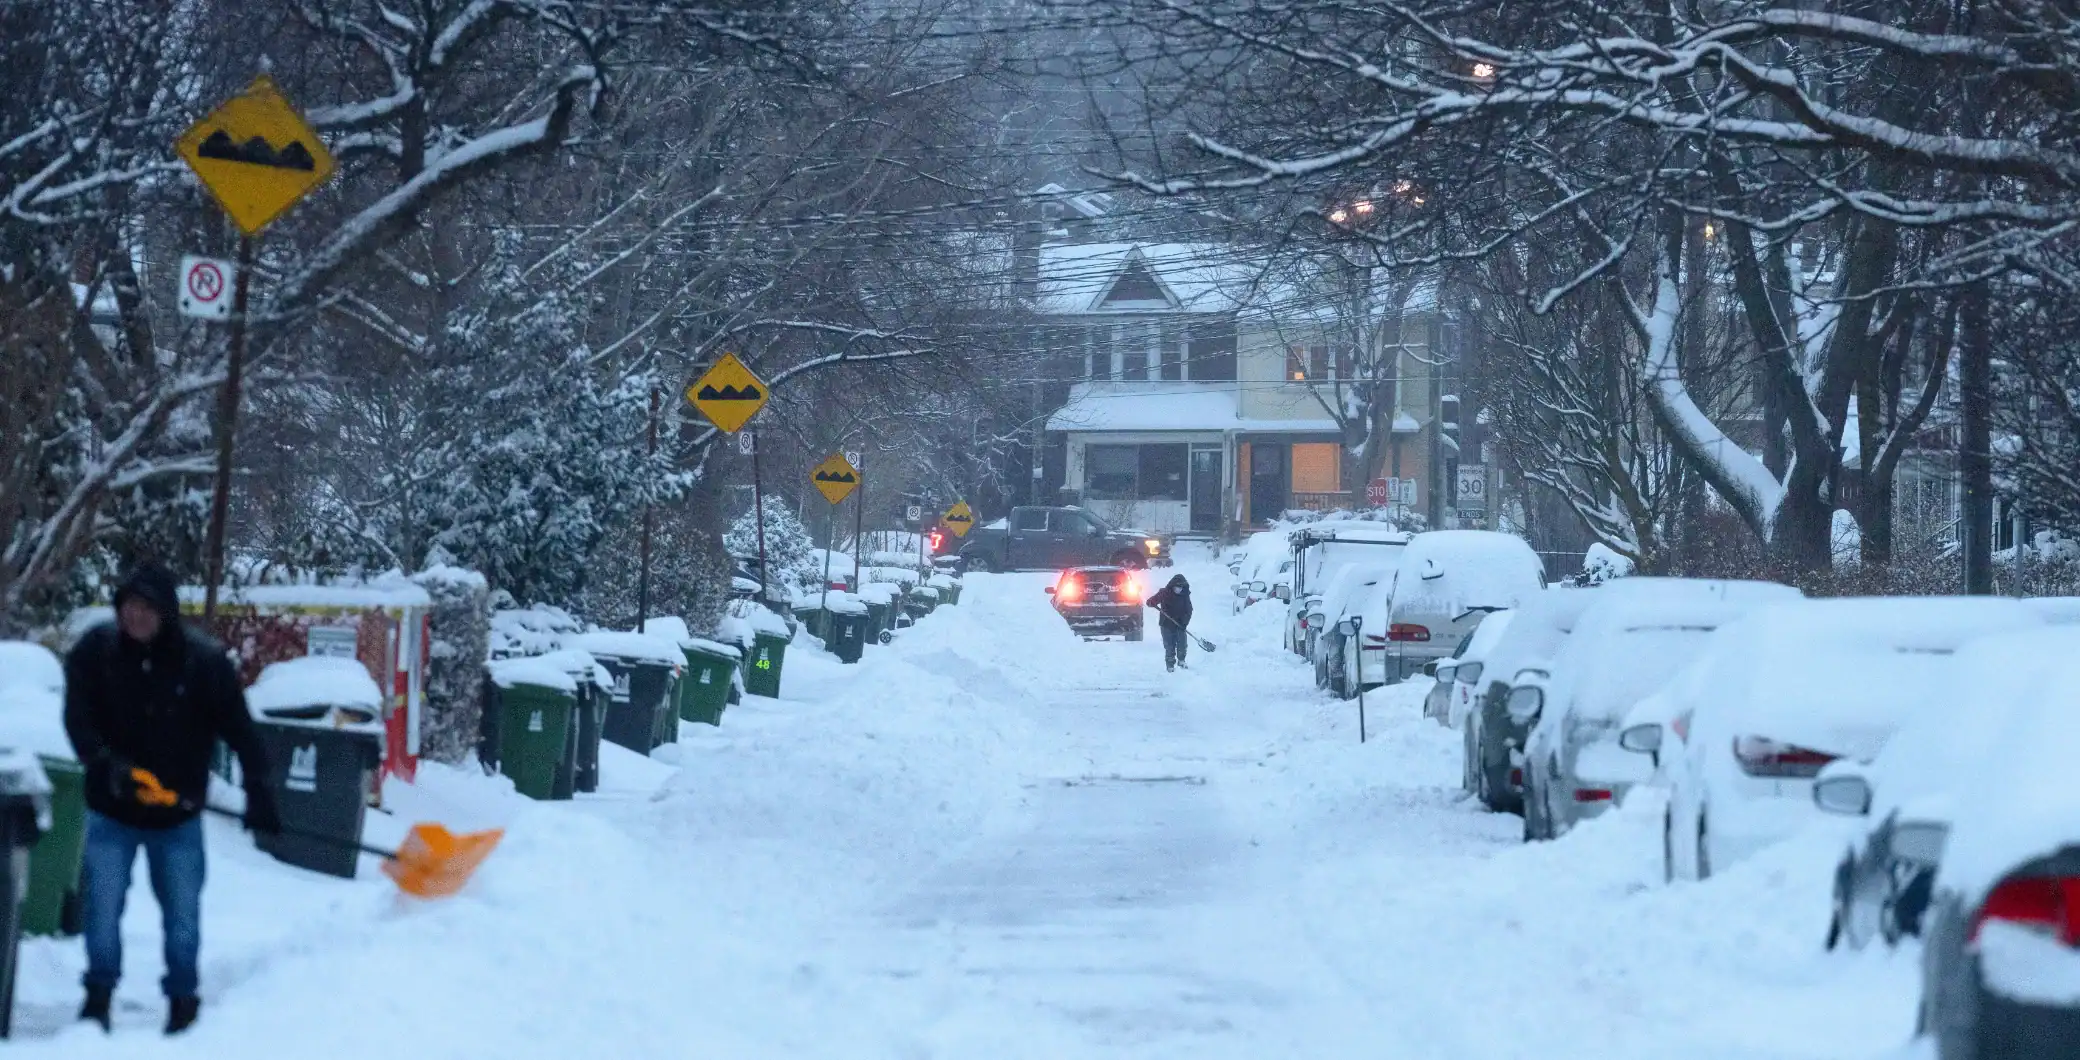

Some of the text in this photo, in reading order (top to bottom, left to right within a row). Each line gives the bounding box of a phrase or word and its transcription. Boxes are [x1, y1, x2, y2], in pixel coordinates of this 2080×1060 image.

[1367, 486, 1385, 497] STO
[1460, 479, 1482, 494] 30
[1461, 510, 1480, 518] ENDS
[755, 659, 770, 670] 48
